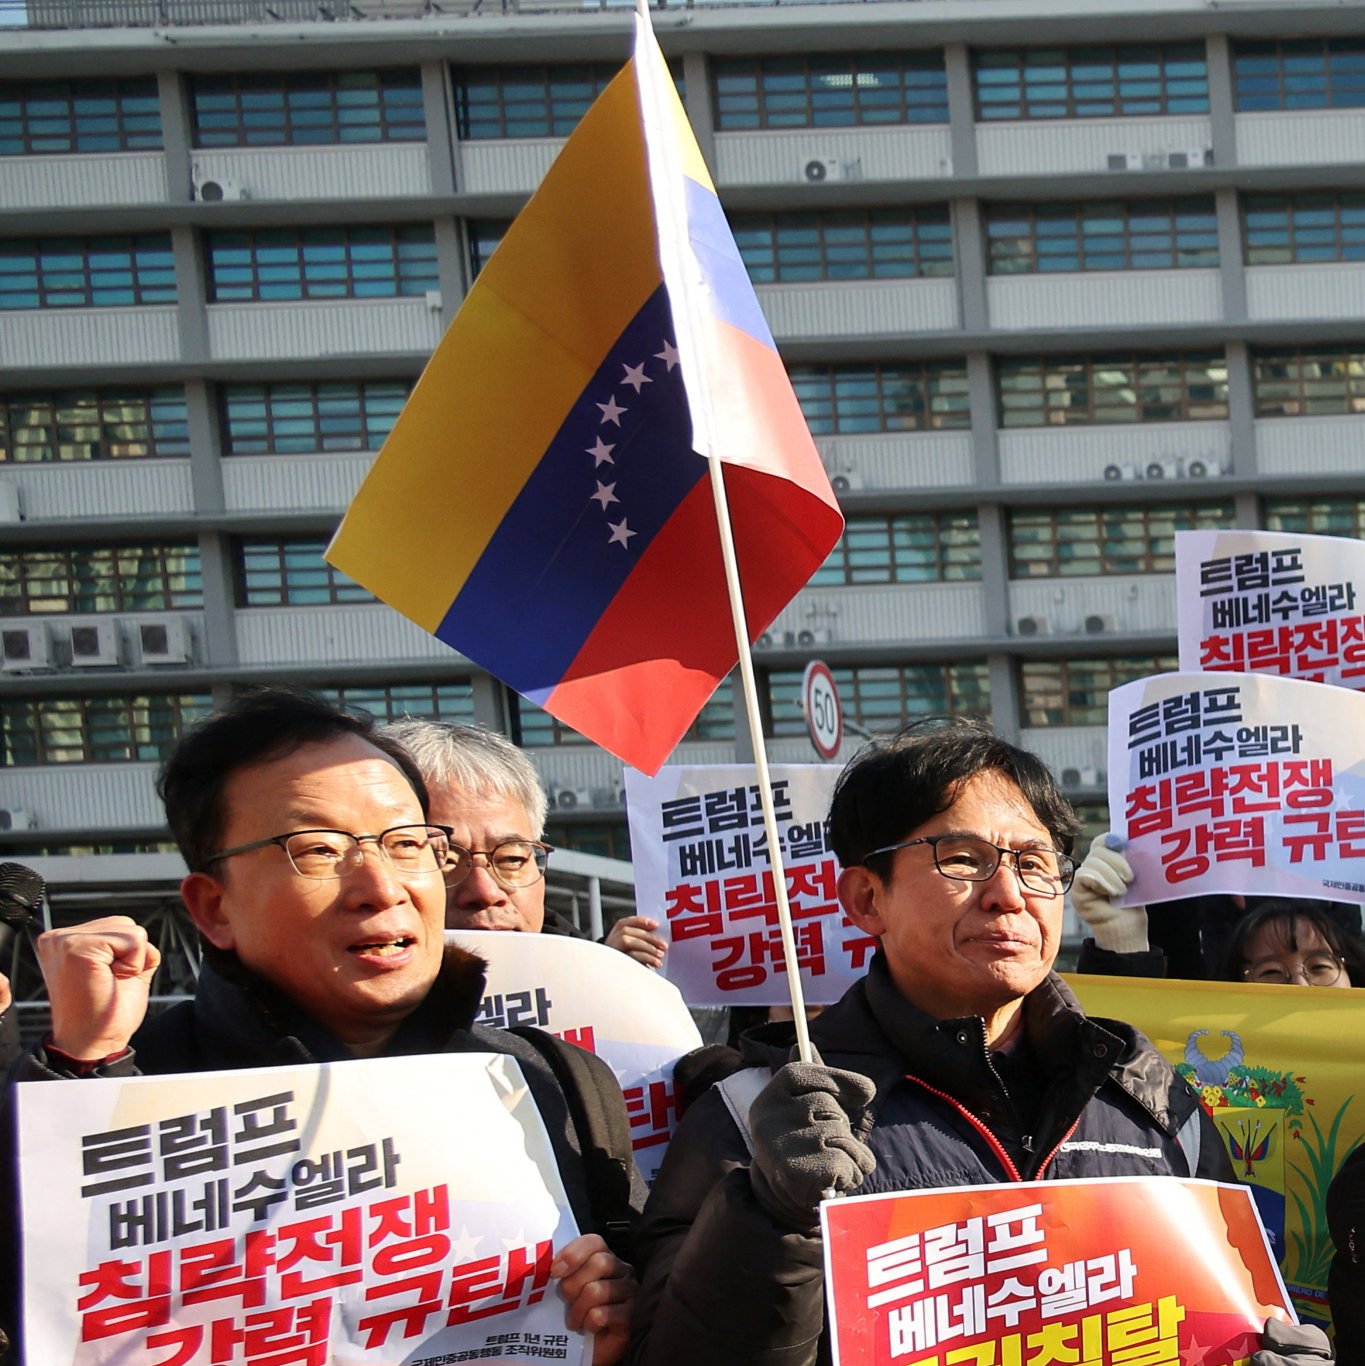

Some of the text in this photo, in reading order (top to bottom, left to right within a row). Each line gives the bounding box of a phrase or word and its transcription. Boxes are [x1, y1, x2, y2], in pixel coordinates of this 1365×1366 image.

[1199, 548, 1304, 597] 트럼프
[1212, 582, 1356, 629] 베네수엘라
[815, 694, 835, 731] 50
[1128, 687, 1242, 749] 트럼프
[1139, 725, 1303, 780] 베네수엘라
[661, 781, 792, 841] 트럼프
[1126, 758, 1333, 840] 침략전쟁
[679, 823, 835, 877] 베네수엘
[1161, 813, 1265, 884] 강력
[665, 859, 843, 942] 침략전
[711, 929, 825, 991] 강력
[81, 1092, 301, 1197] 트럼프
[109, 1137, 401, 1252] 베네수엘라
[78, 1184, 451, 1343] 침략전쟁
[867, 1204, 1048, 1309] 트럼프
[358, 1240, 554, 1348] 규탄!
[888, 1249, 1138, 1359] 베네수엘라
[485, 1332, 520, 1346] 트럼프
[543, 1334, 569, 1347] 규탄
[504, 1345, 567, 1360] 조직위원회
